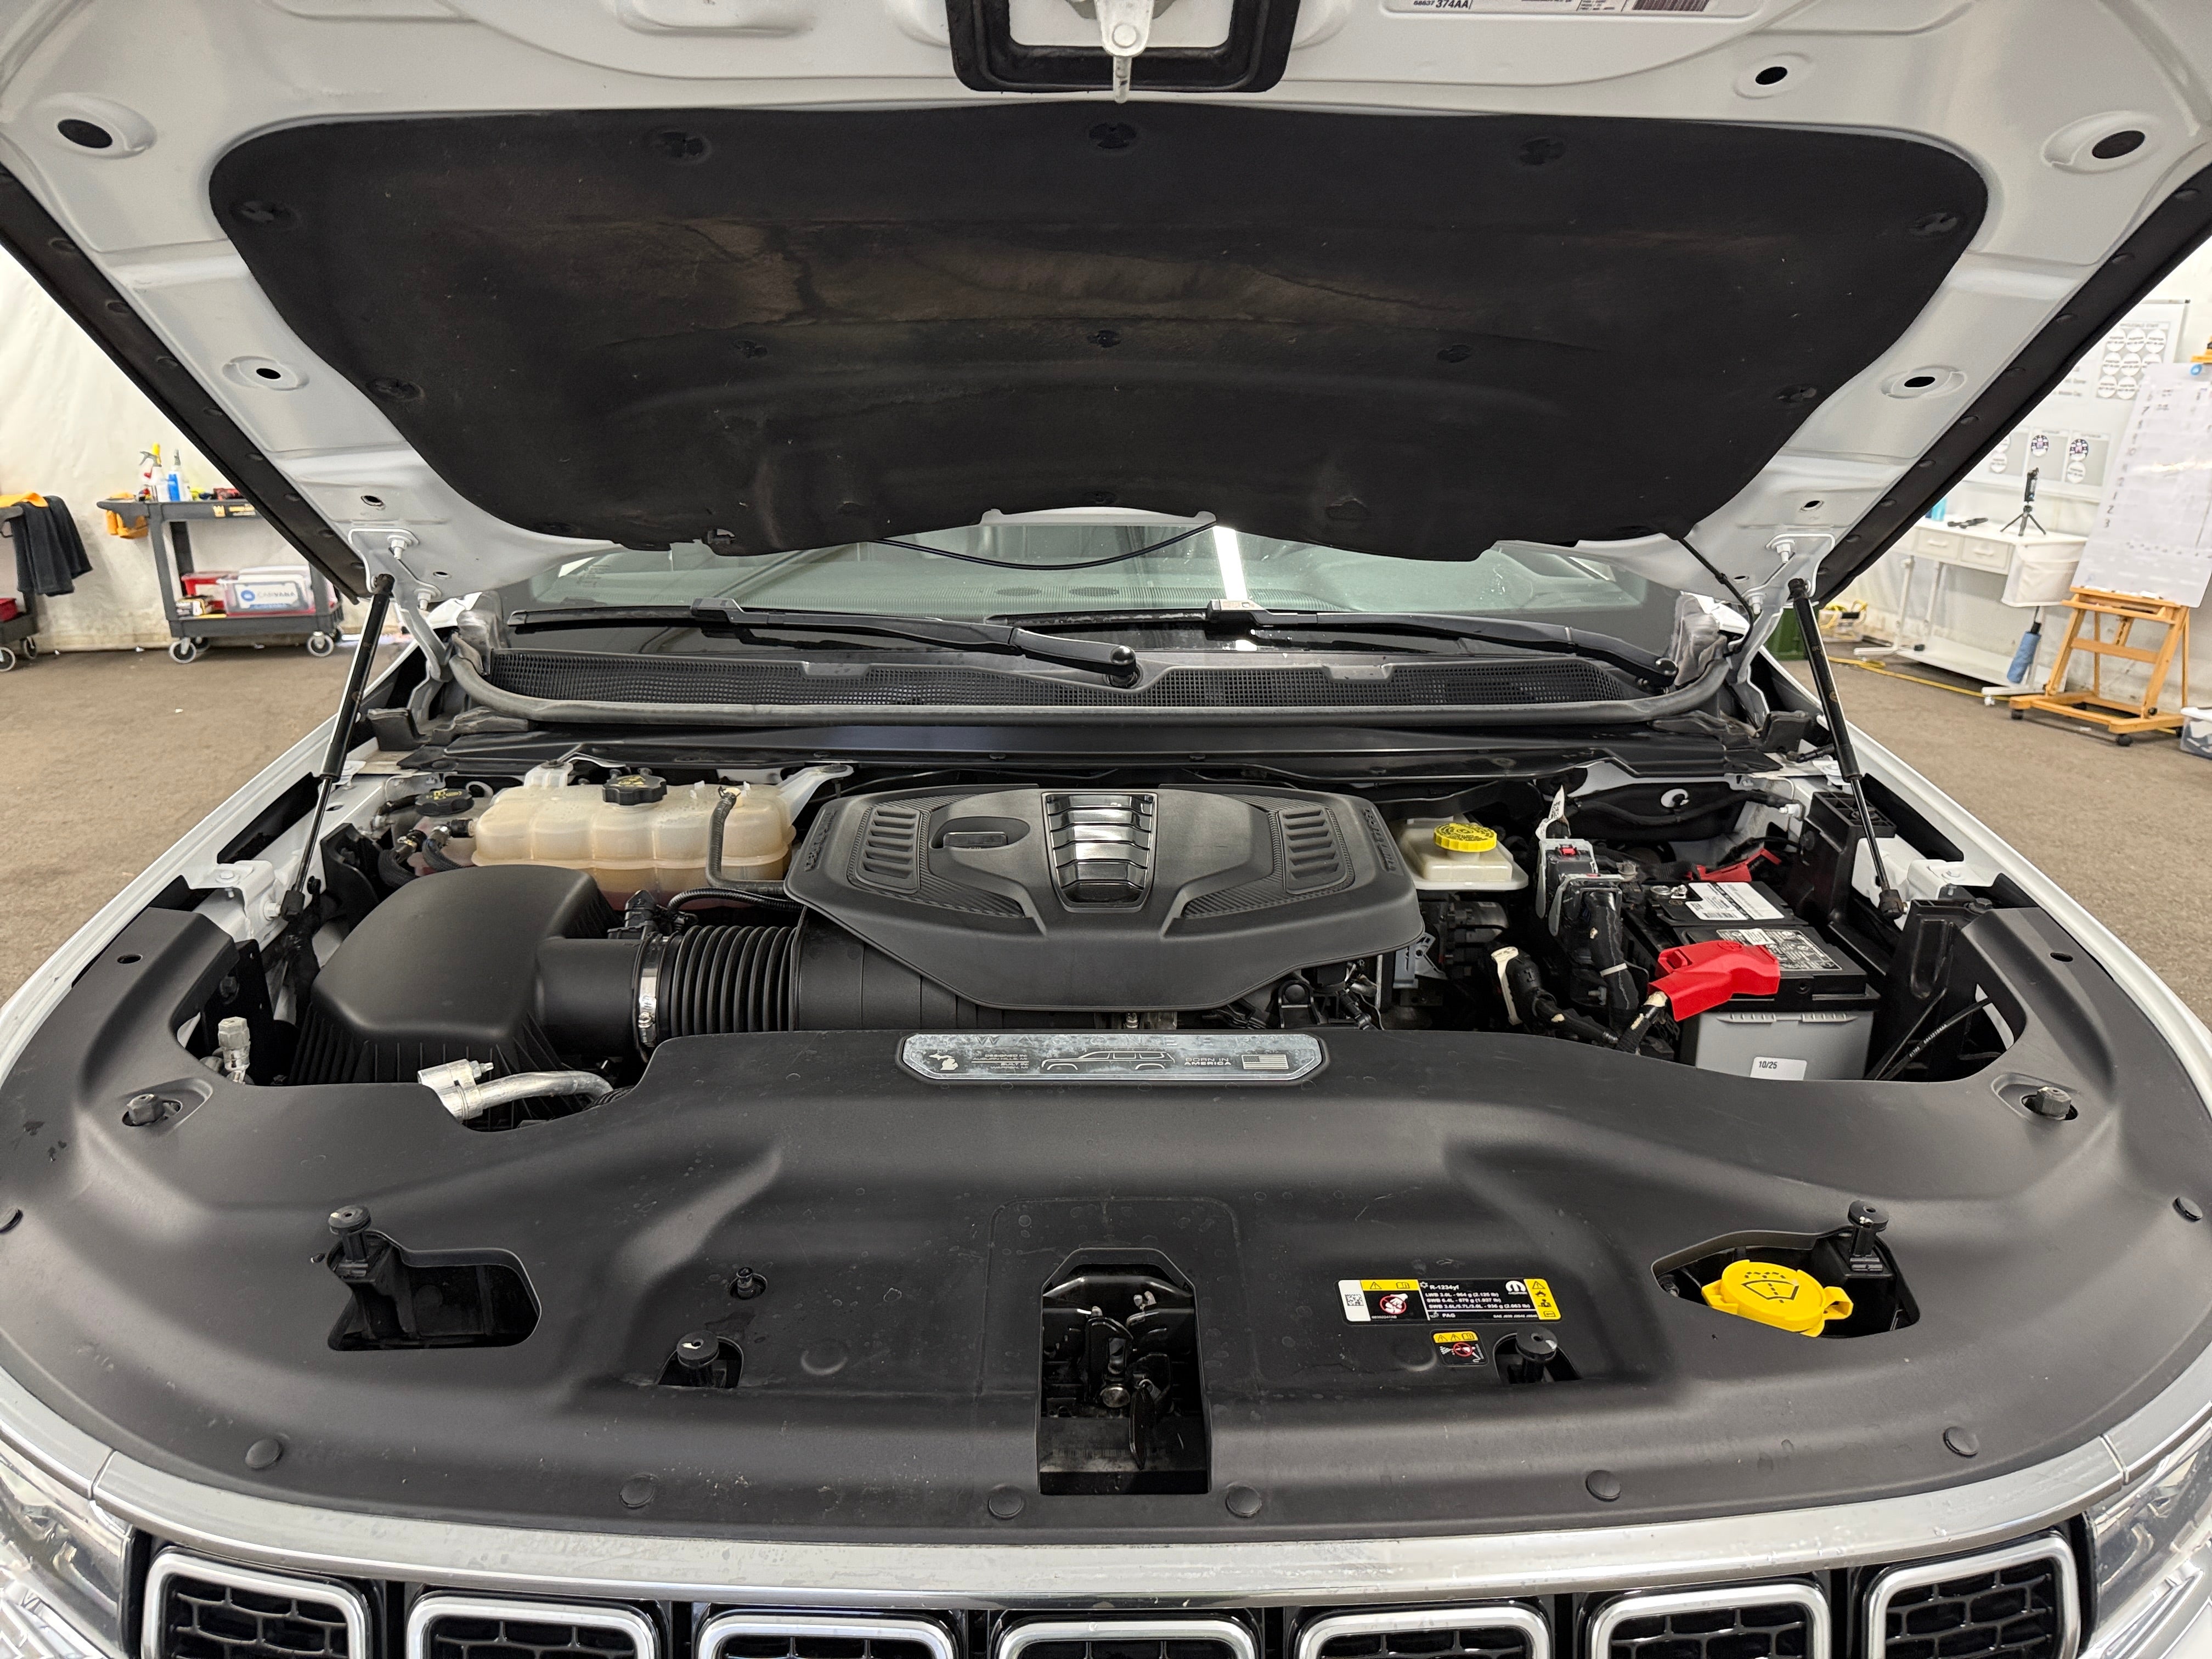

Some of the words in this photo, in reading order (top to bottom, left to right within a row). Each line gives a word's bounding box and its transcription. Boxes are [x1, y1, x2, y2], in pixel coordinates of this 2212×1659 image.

[2141, 406, 2149, 415] 7
[2107, 505, 2114, 514] 2
[2104, 519, 2111, 528] 3
[1758, 1061, 1777, 1070] 10/25
